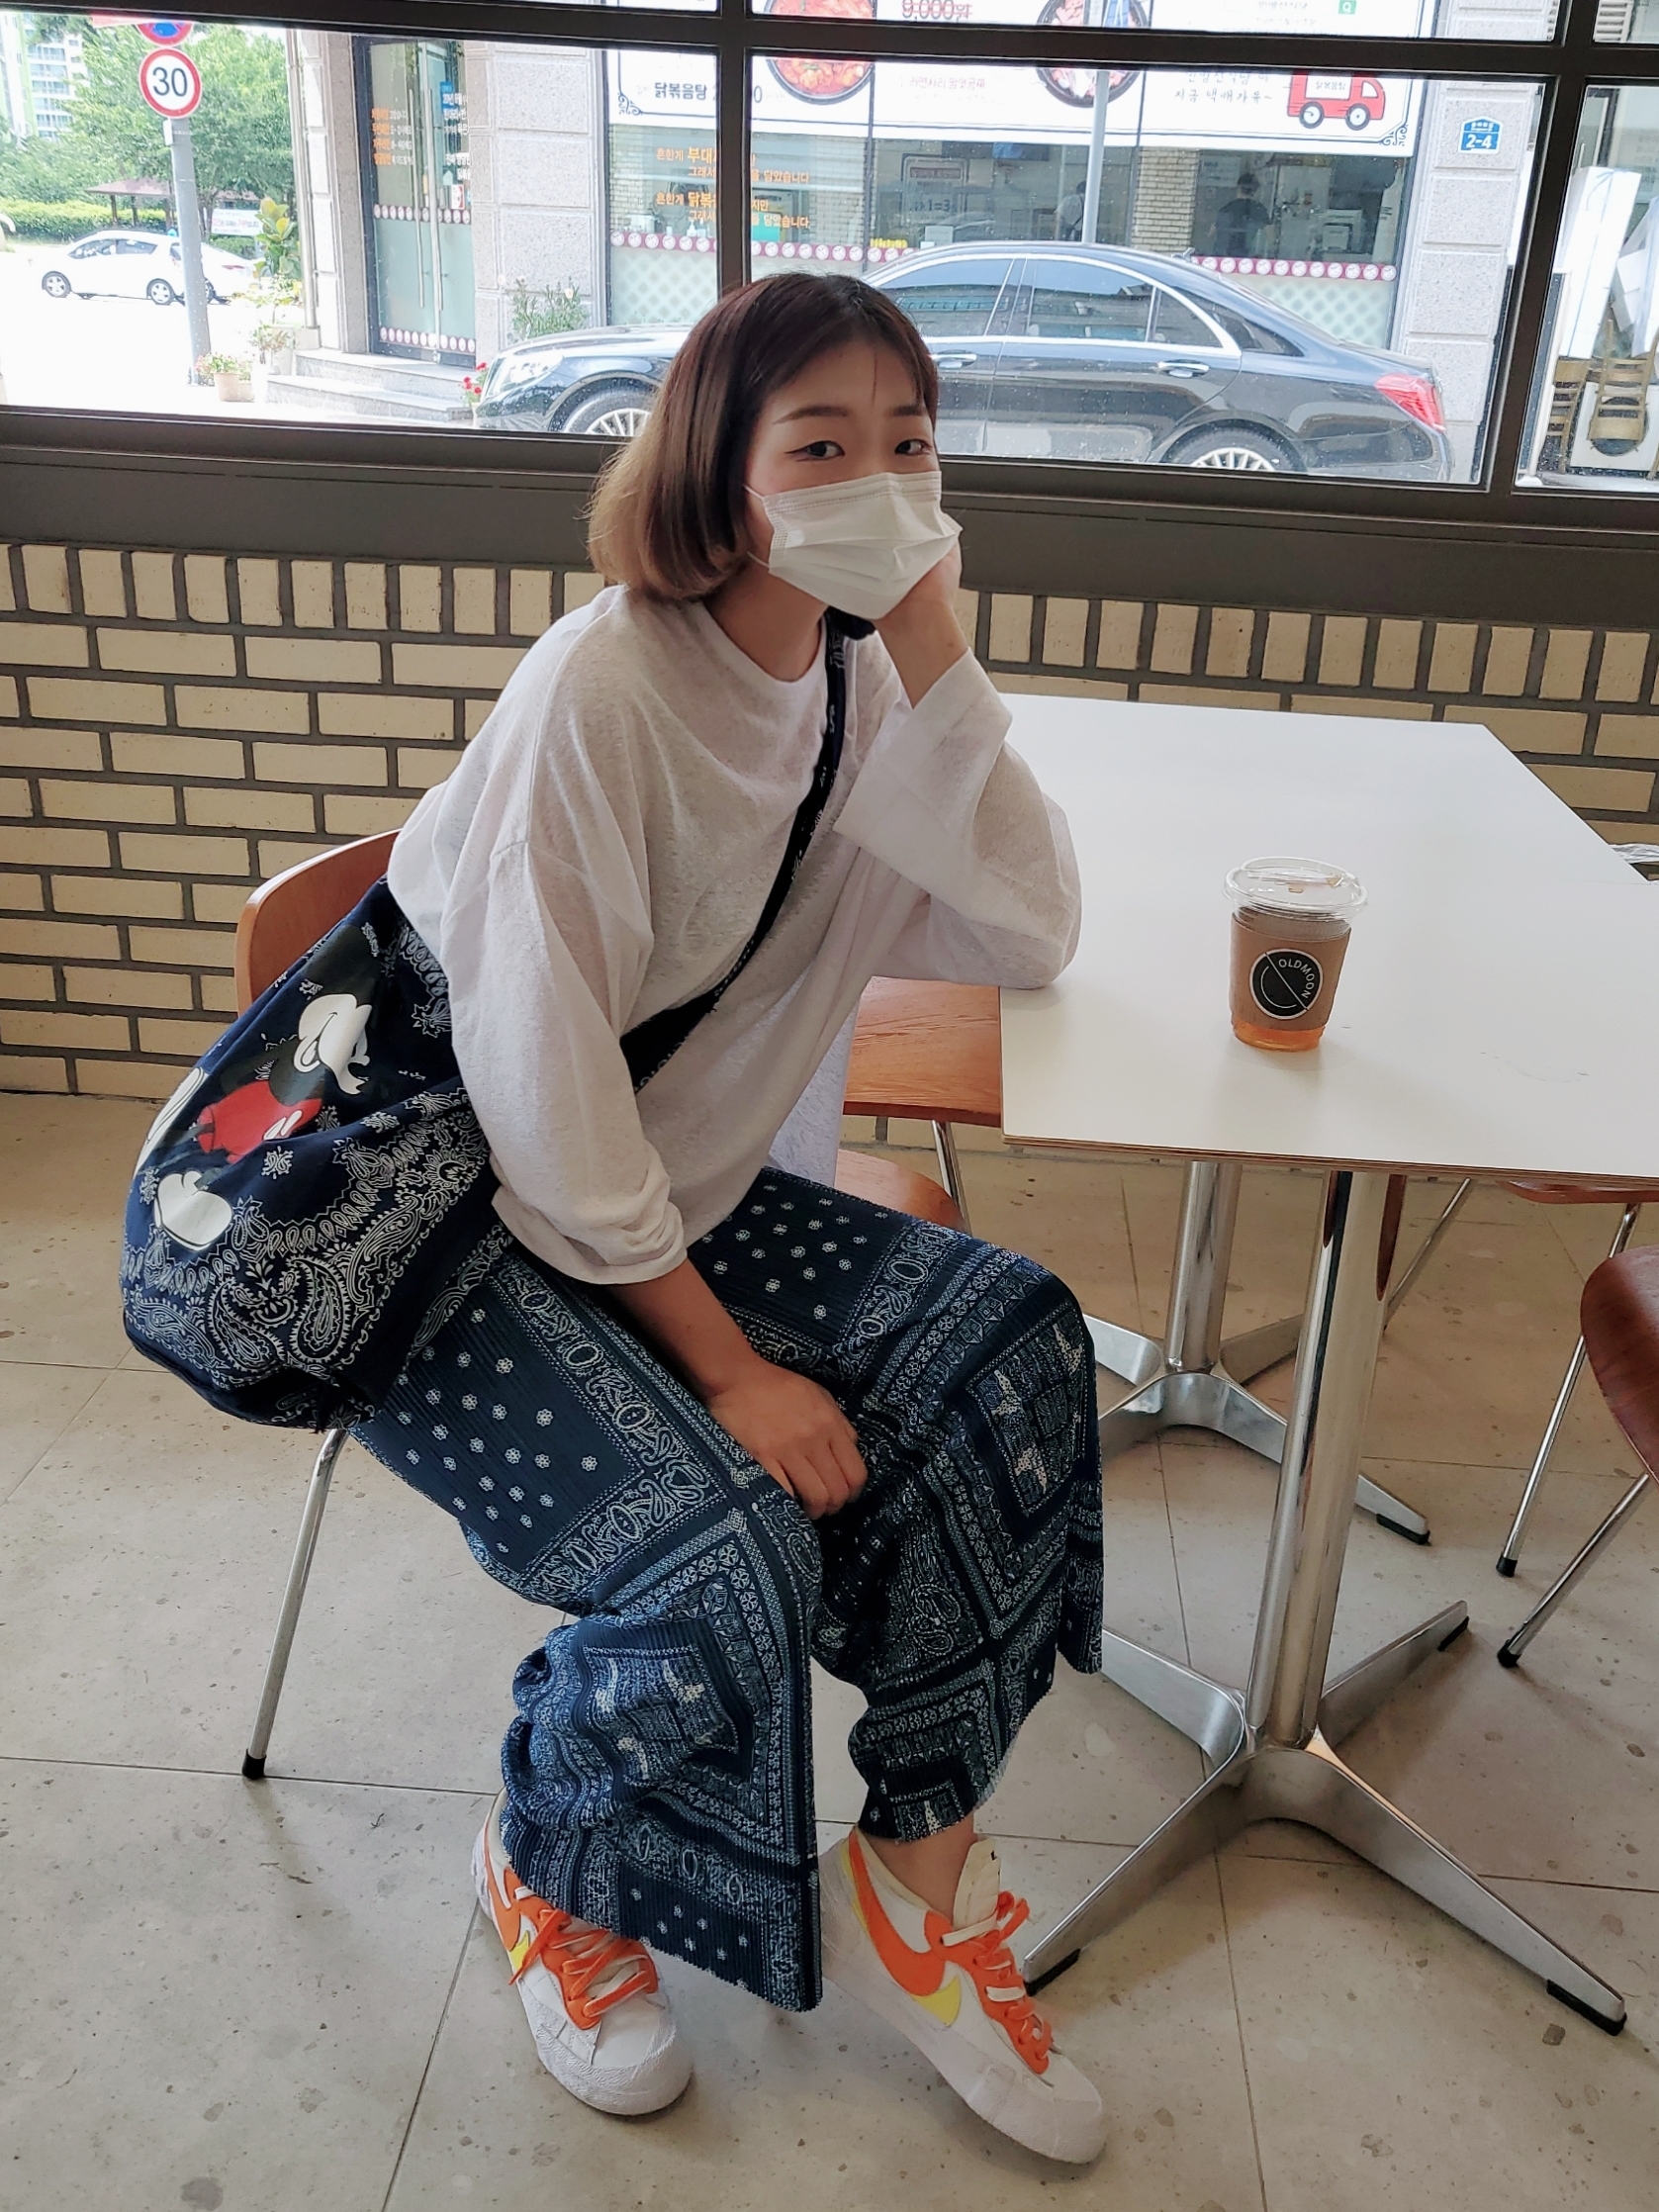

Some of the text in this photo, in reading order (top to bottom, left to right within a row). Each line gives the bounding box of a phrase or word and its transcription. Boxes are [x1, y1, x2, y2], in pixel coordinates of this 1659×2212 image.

[152, 67, 188, 97] 30
[654, 82, 707, 100] 닭볶음탕
[1466, 134, 1492, 148] 2-4
[656, 148, 684, 162] 흔한게
[764, 169, 809, 184] 담았습니다
[656, 192, 685, 206] 흔한게
[764, 215, 809, 229] 담았습니다
[1278, 958, 1315, 999] OLDMOON
